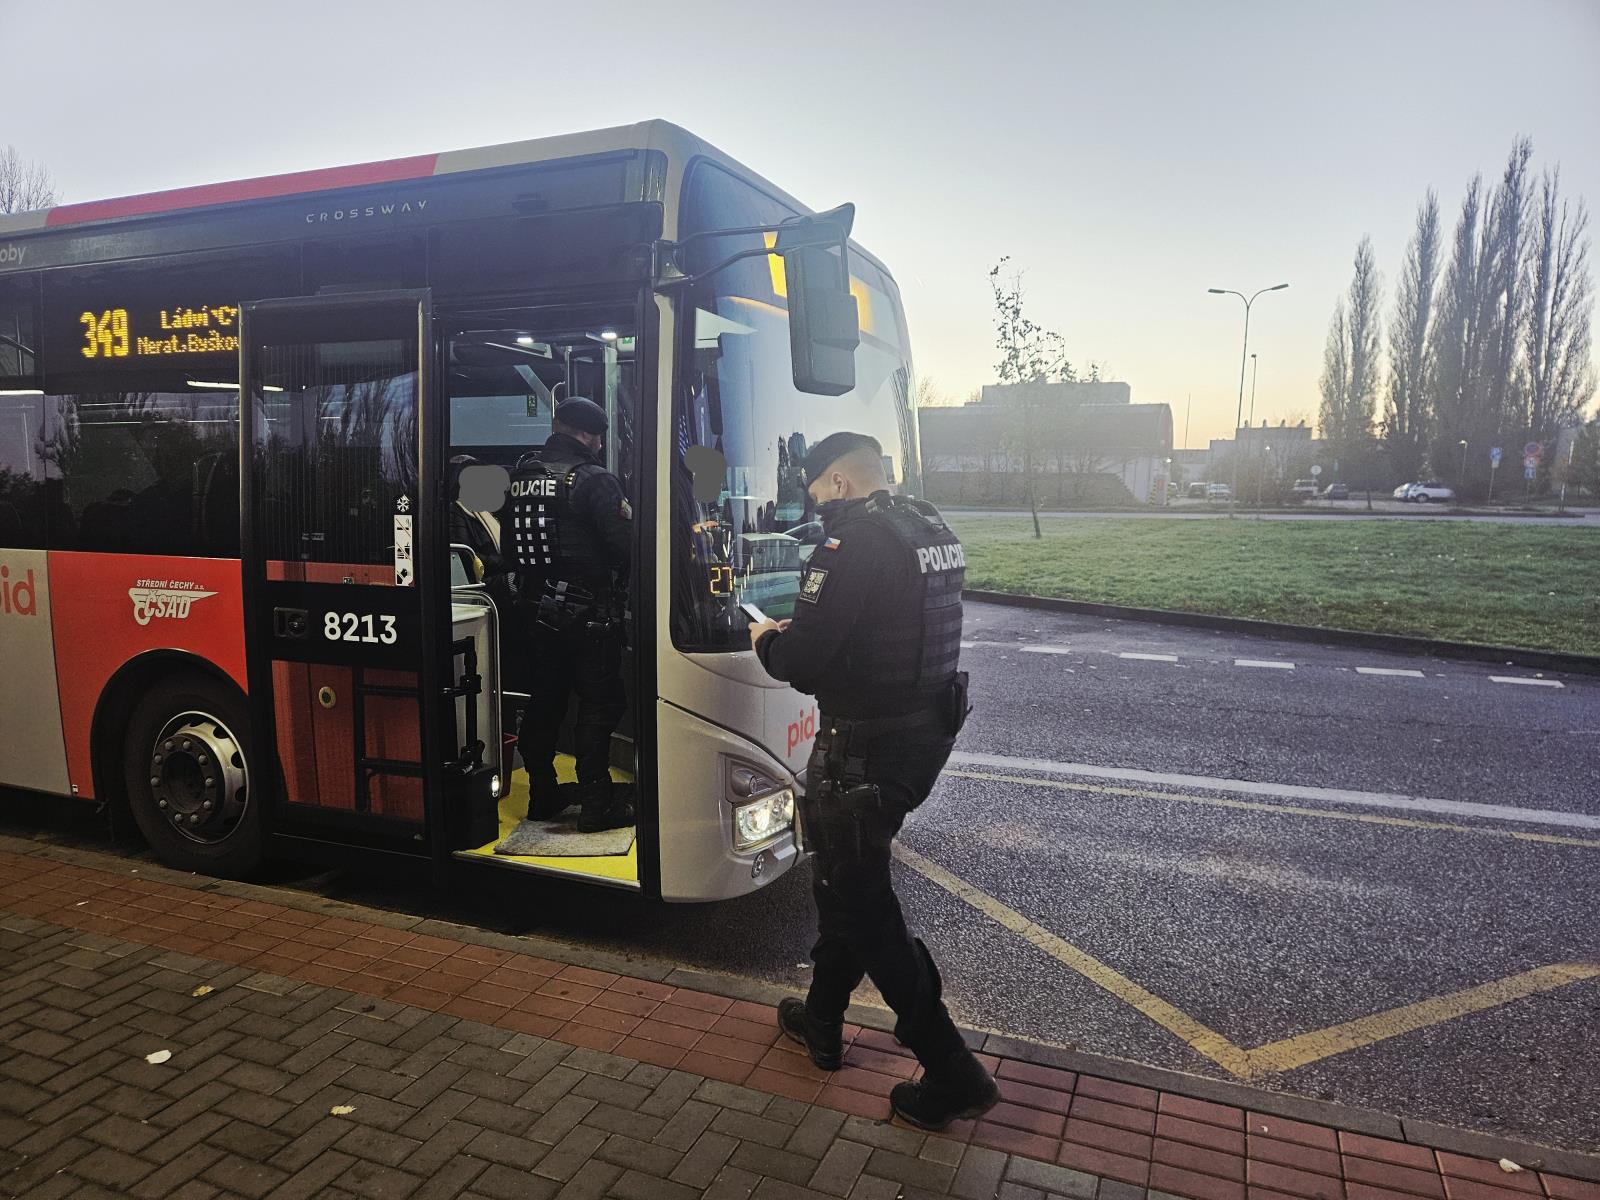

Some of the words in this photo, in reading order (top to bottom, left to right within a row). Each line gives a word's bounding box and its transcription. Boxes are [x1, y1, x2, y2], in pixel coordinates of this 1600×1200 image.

[306, 200, 427, 223] CROSSWAY
[160, 305, 209, 329] Ládví
[80, 309, 128, 358] 349
[510, 479, 557, 497] OLICIE
[0, 564, 37, 616] id
[169, 580, 195, 590] ČECHY
[710, 566, 733, 594] 27
[143, 589, 192, 619] ČSAD
[324, 611, 398, 645] 8213
[787, 705, 815, 759] pid
